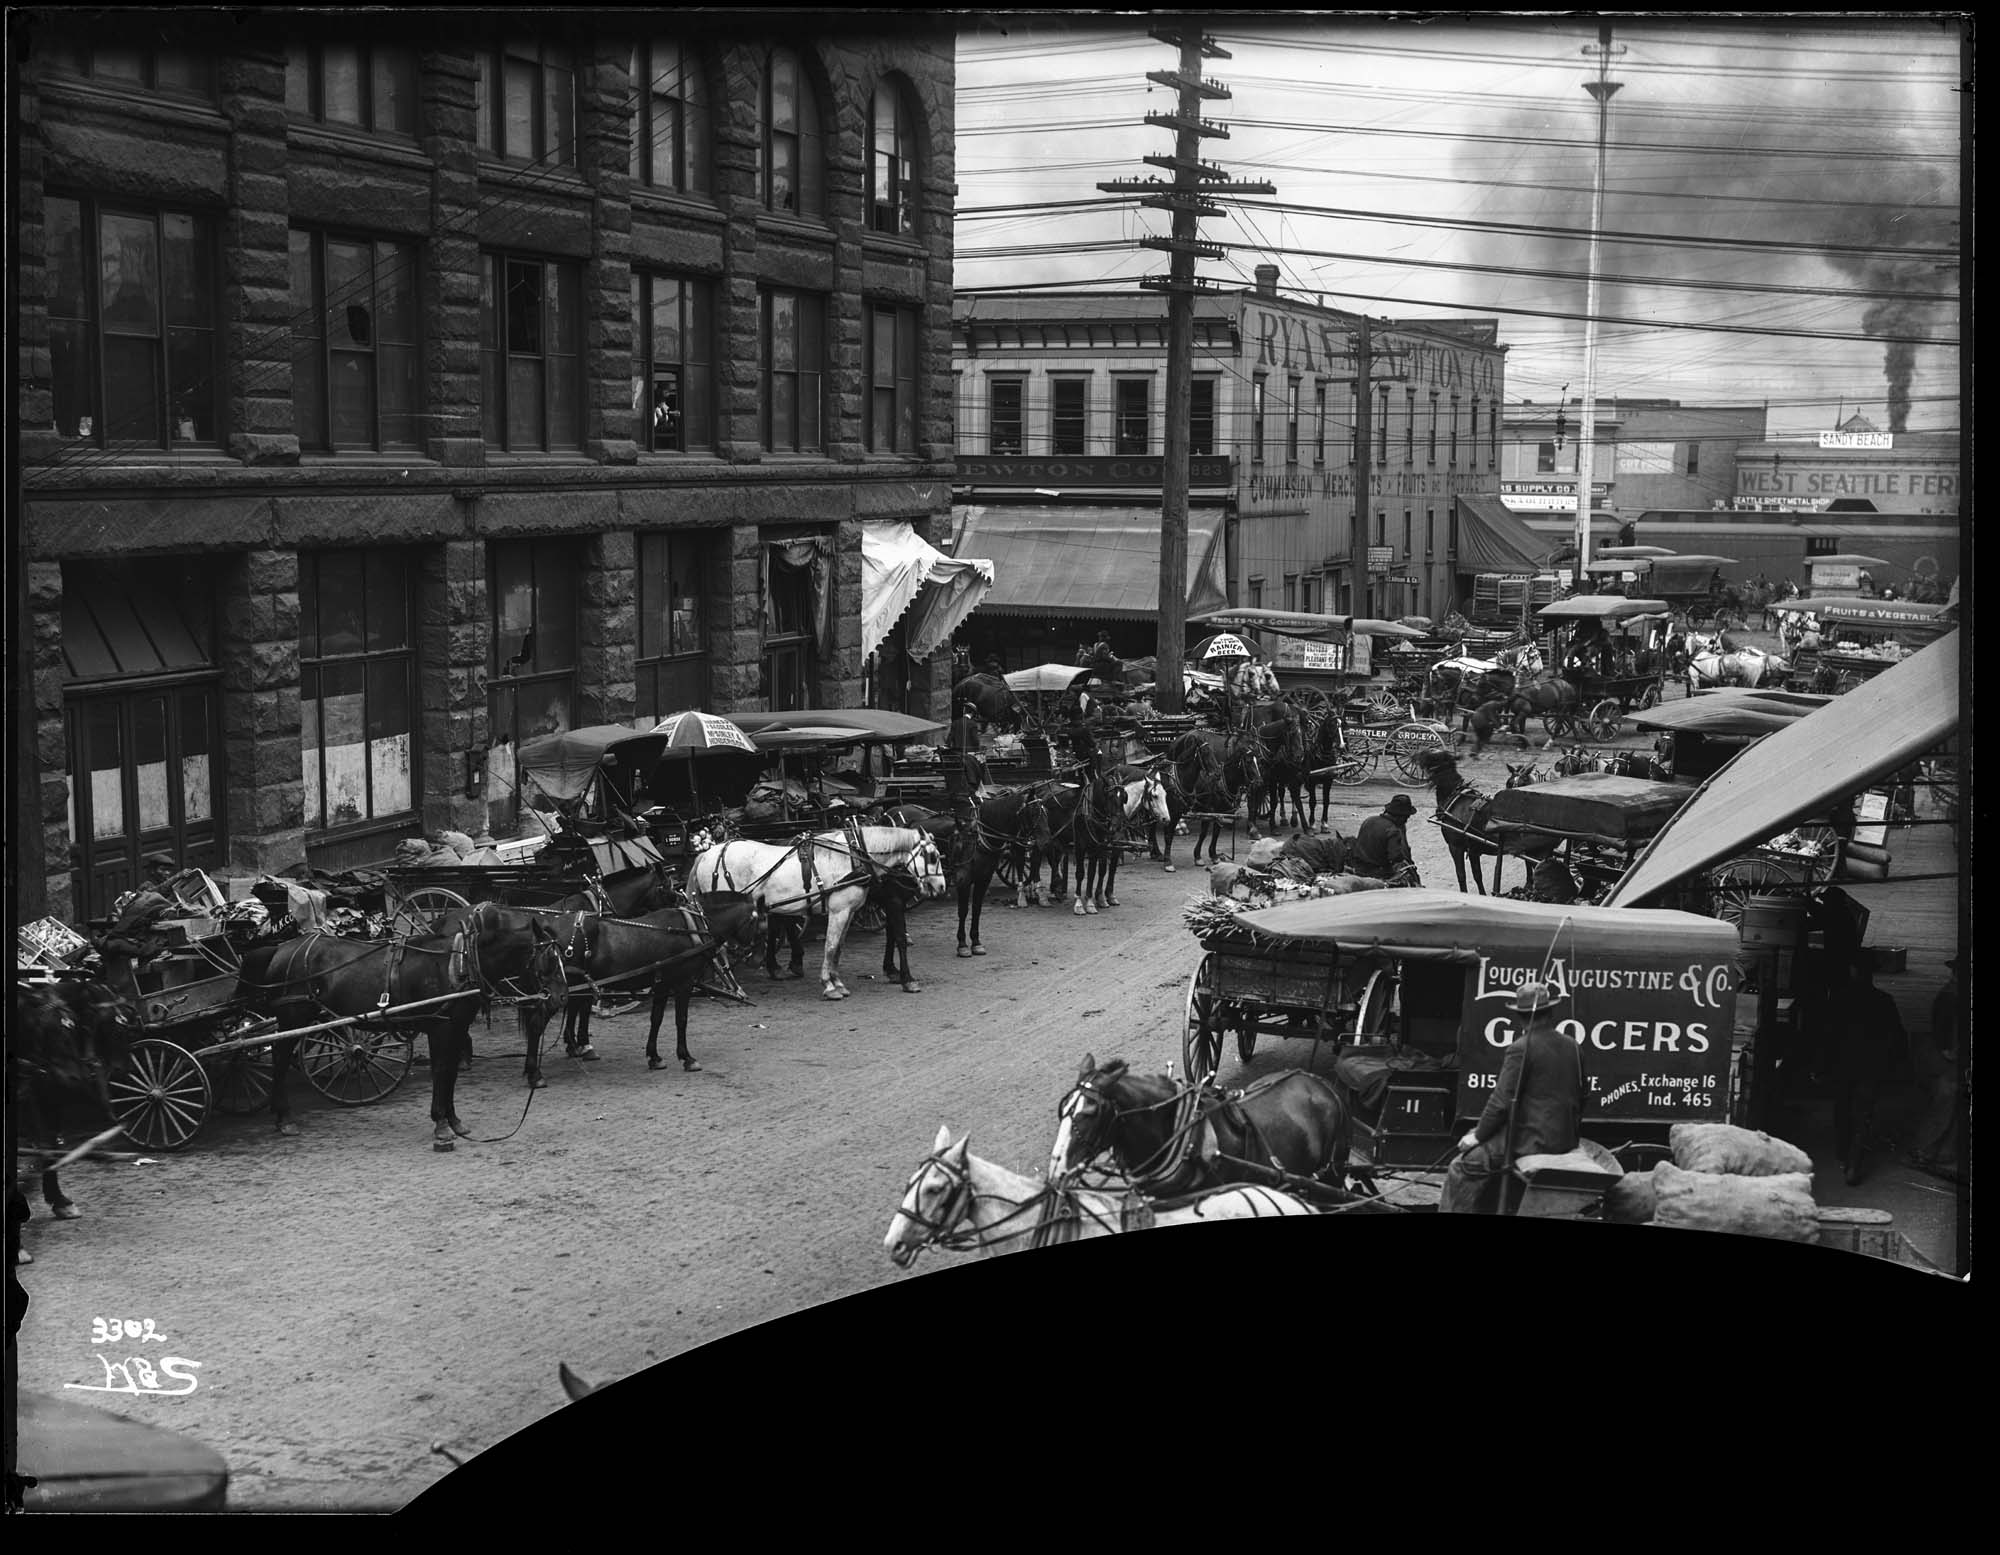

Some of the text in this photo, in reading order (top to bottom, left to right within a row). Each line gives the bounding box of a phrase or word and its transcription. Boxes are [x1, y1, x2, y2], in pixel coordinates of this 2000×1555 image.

[1822, 433, 1890, 447] SANDY BEACH
[1251, 474, 1313, 503] COMMISSION
[1515, 484, 1554, 493] SUPPLY
[1741, 471, 1800, 493] WEST
[1807, 472, 1899, 494] SEATTLE
[1733, 497, 1764, 505] SEATTLE
[1764, 497, 1787, 505] SHEET
[1824, 605, 1867, 618] FRUITS
[1211, 616, 1328, 627] WHOLESALE COMMISSION
[1209, 643, 1244, 654] RAINIER
[1545, 958, 1674, 998] AUGUSTINE
[1679, 964, 1705, 1008] &
[1484, 1016, 1710, 1053] GOCERS
[1467, 1073, 1497, 1088] 815
[1641, 1072, 1699, 1093] Exchange
[1703, 1074, 1716, 1088] 16
[1648, 1092, 1712, 1107] Ind. 465
